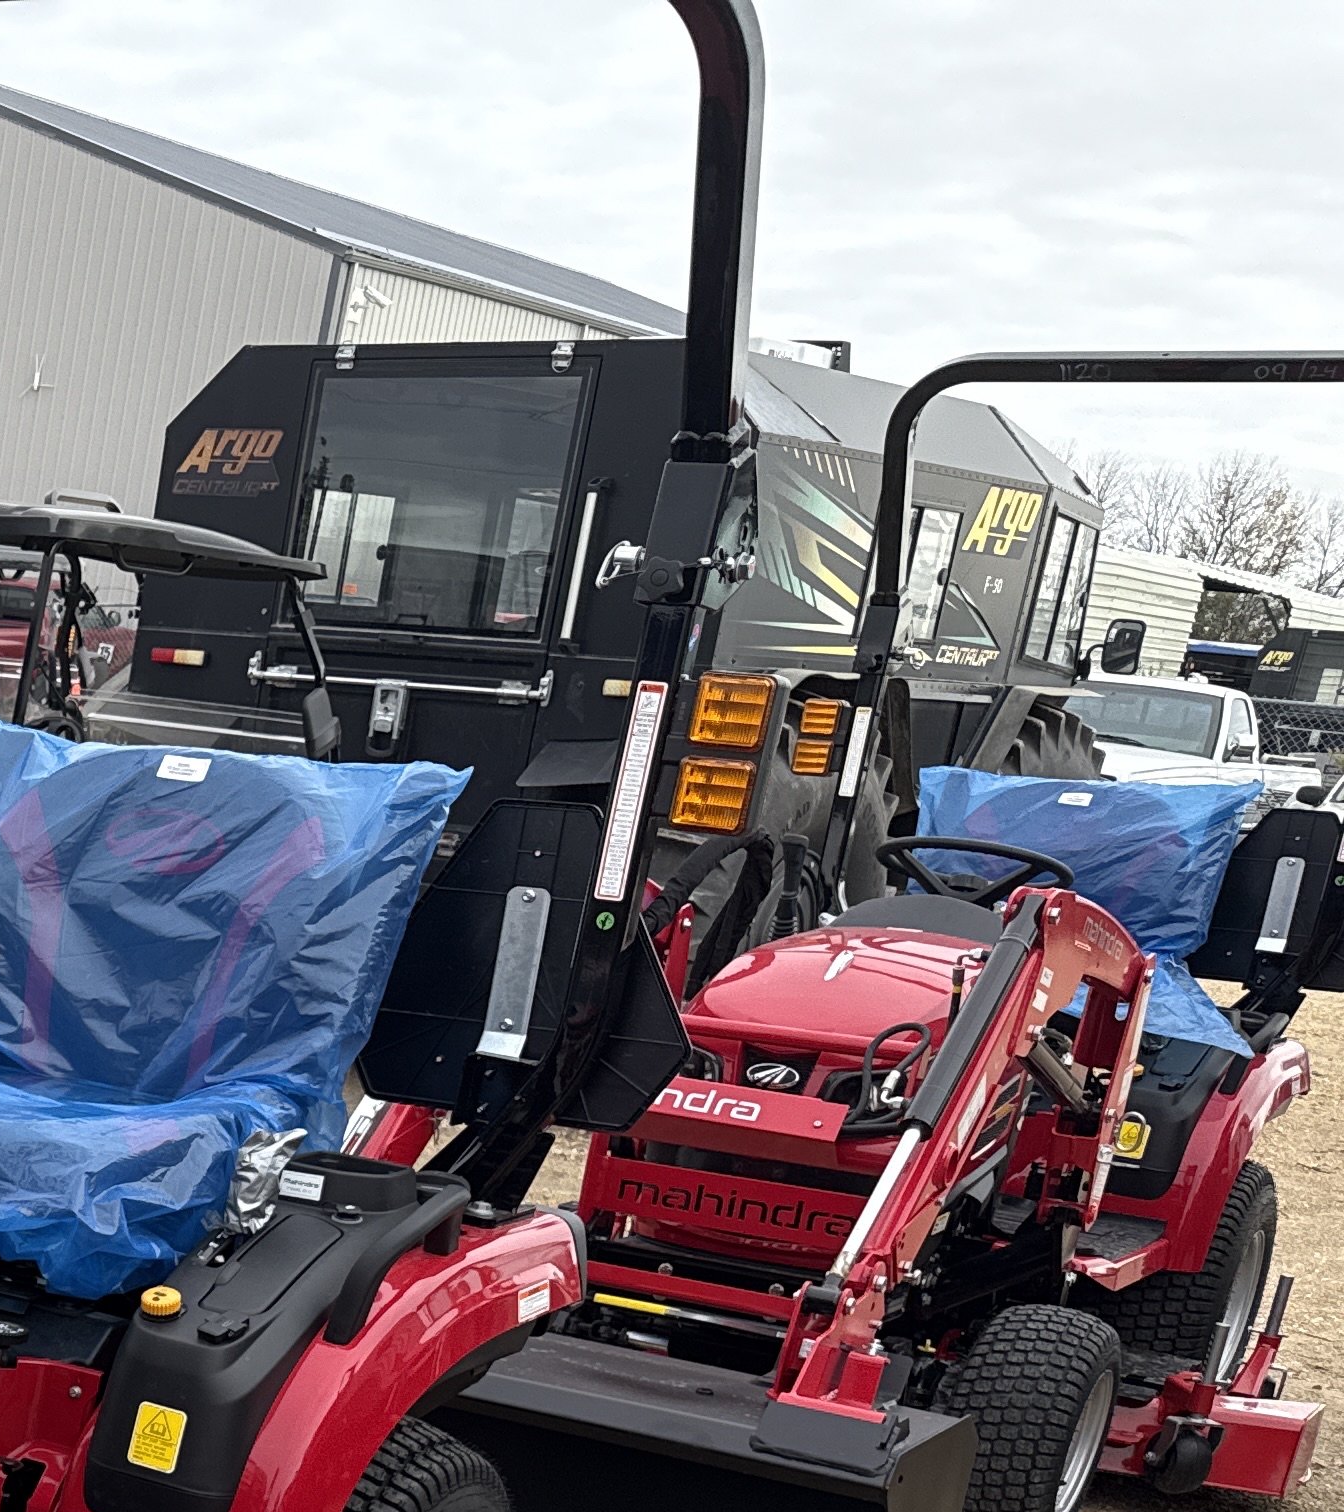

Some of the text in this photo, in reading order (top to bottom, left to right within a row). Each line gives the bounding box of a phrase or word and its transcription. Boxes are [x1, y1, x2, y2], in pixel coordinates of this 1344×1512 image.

[176, 429, 284, 475] Argo
[961, 486, 1044, 556] Argo
[1260, 650, 1295, 666] Argo
[1082, 916, 1124, 961] mahindra
[617, 1178, 858, 1237] mahindra
